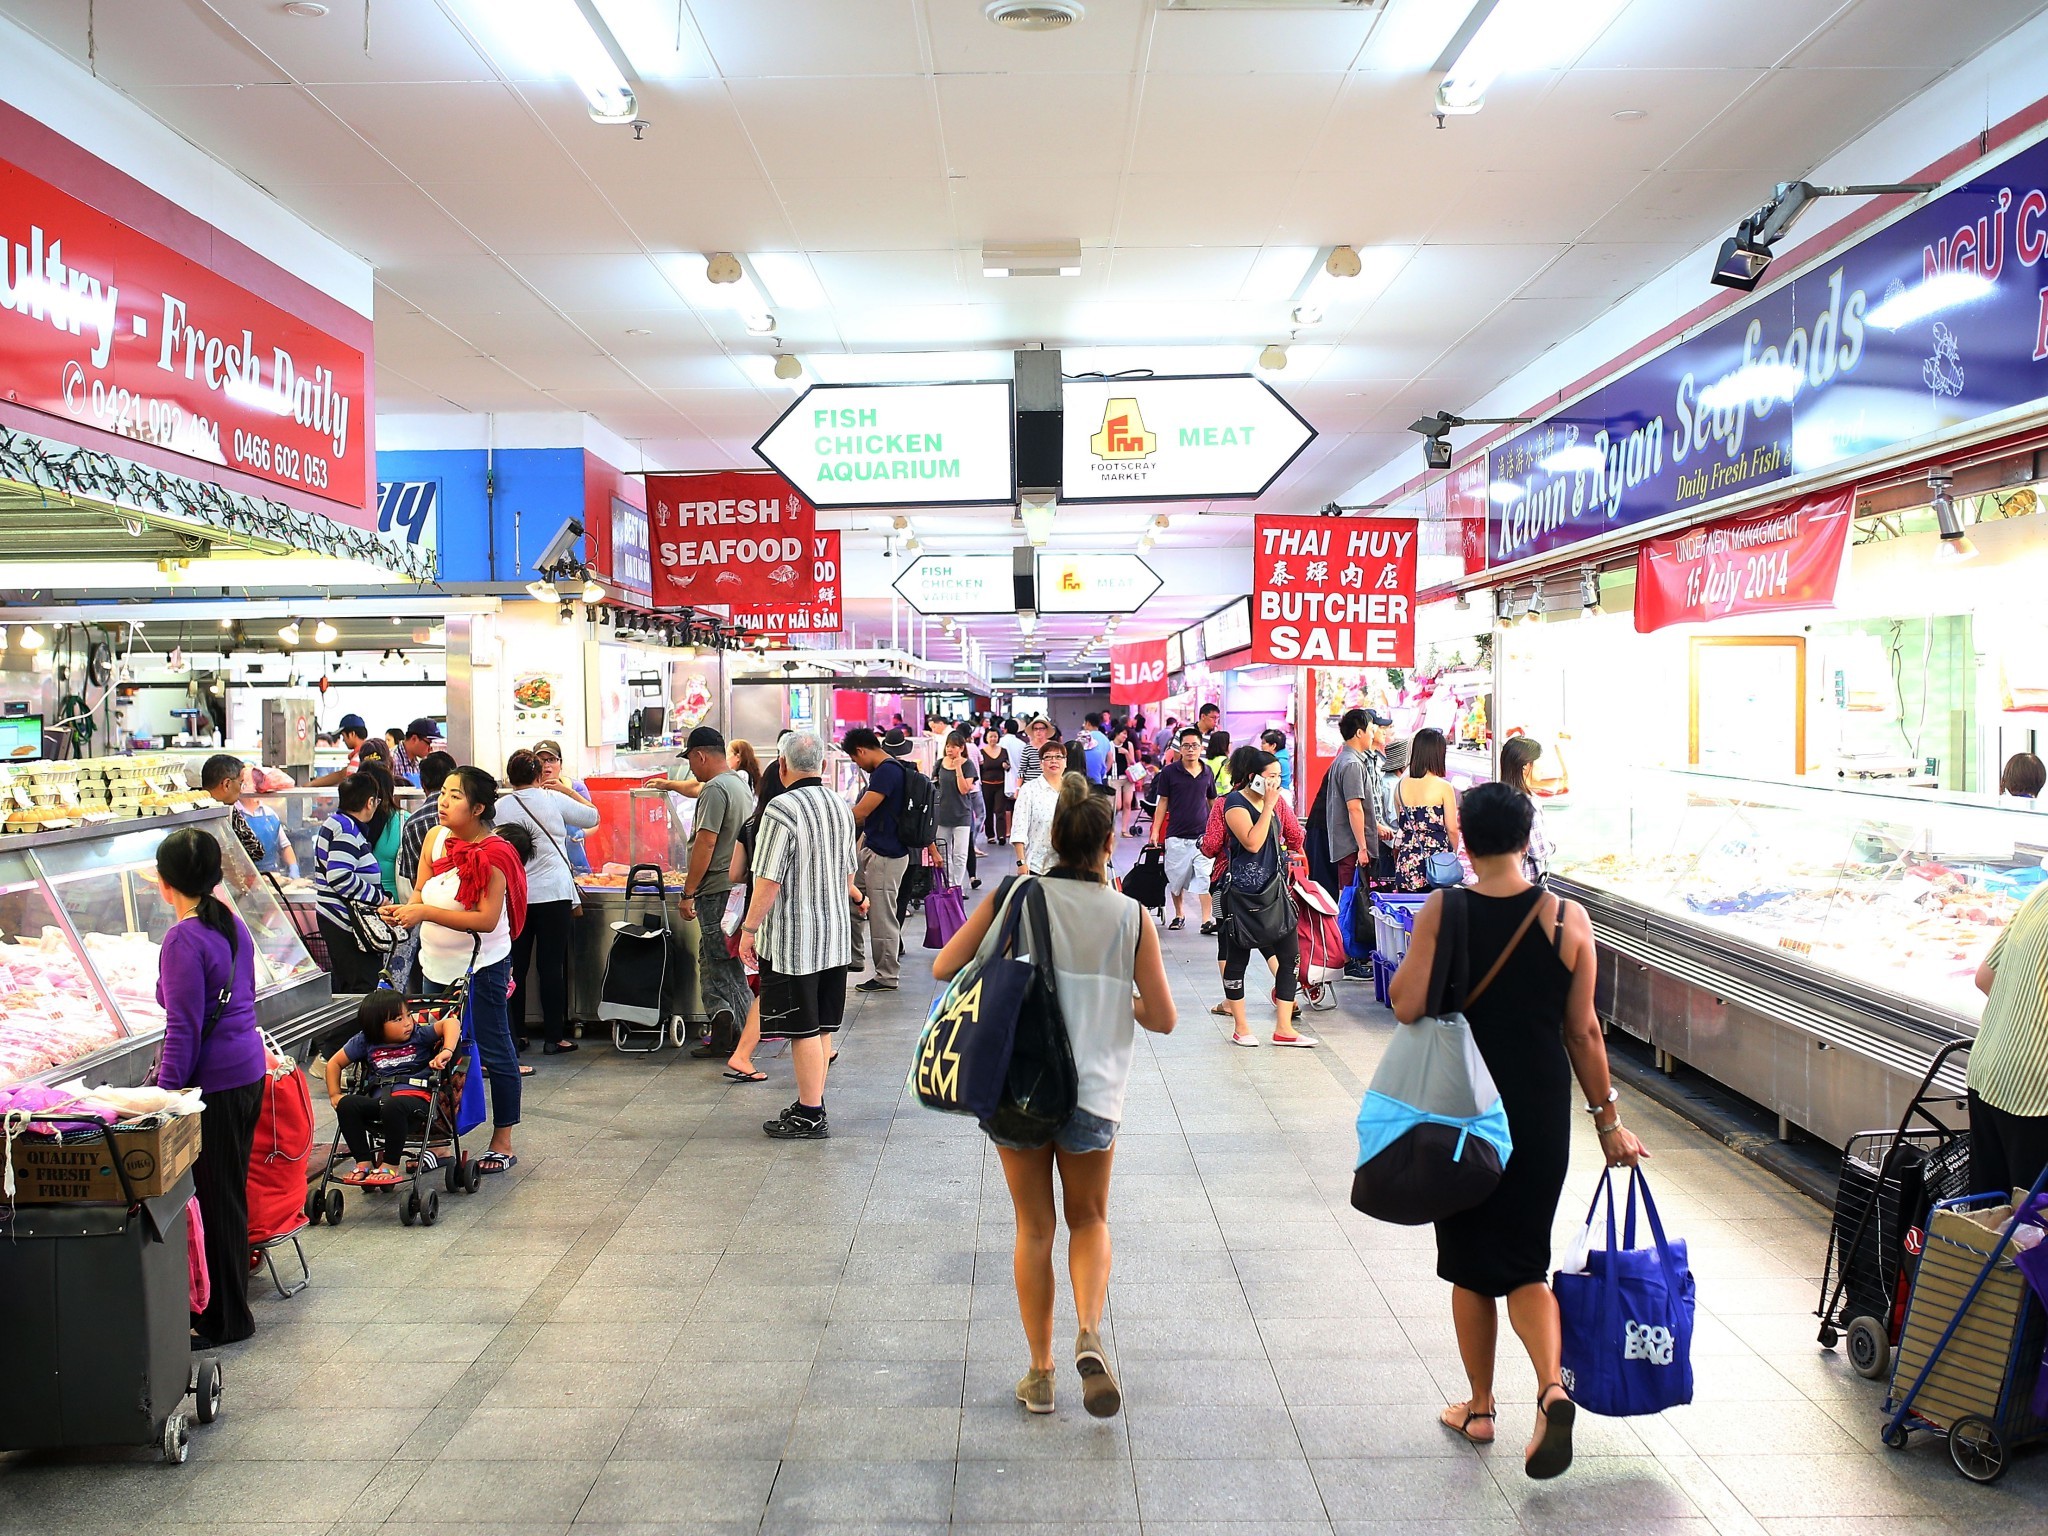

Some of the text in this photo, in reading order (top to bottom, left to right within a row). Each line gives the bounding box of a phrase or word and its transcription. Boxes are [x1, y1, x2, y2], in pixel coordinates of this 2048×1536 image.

[2016, 189, 2048, 267] C
[157, 292, 261, 396] Fresh
[273, 346, 349, 459] Daily
[814, 408, 877, 428] FISH
[1497, 265, 1867, 559] Kelvin & Ryan Seafoods
[92, 379, 142, 431] 0421
[234, 428, 271, 472] 0466
[275, 443, 300, 481] 602
[303, 453, 329, 489] 053
[815, 433, 942, 455] CHICKEN
[1179, 426, 1255, 447] MEAT
[816, 459, 960, 482] AQUARIUM
[1091, 462, 1157, 472] FOOTSCRAY
[1101, 472, 1147, 481] MARKET
[1676, 466, 1708, 502] Daily
[1710, 454, 1748, 490] Fresh
[1751, 441, 1780, 482] Fish
[1783, 446, 1793, 466] &
[678, 499, 780, 527] FRESH
[1262, 528, 1332, 556] THAI
[1346, 530, 1413, 558] HUY
[1706, 527, 1730, 555] NEW
[1731, 512, 1801, 551] MANAGMENT
[660, 537, 802, 567] SEAFOOD
[921, 567, 952, 576] FISH
[1096, 578, 1134, 588] MEAT
[1686, 549, 1790, 613] 15 July 2014
[921, 579, 984, 589] CHICKEN
[921, 592, 980, 601] VARIETY
[1260, 591, 1409, 624] BUTCHER
[733, 613, 764, 630] KHAI
[766, 613, 785, 629] KY
[812, 607, 839, 628] SẢN
[1269, 626, 1397, 662] SALE
[27, 1151, 100, 1166] QUALITY
[36, 1168, 91, 1182] FRESH
[39, 1184, 90, 1198] FRUIT
[1624, 1335, 1674, 1366] BAG
